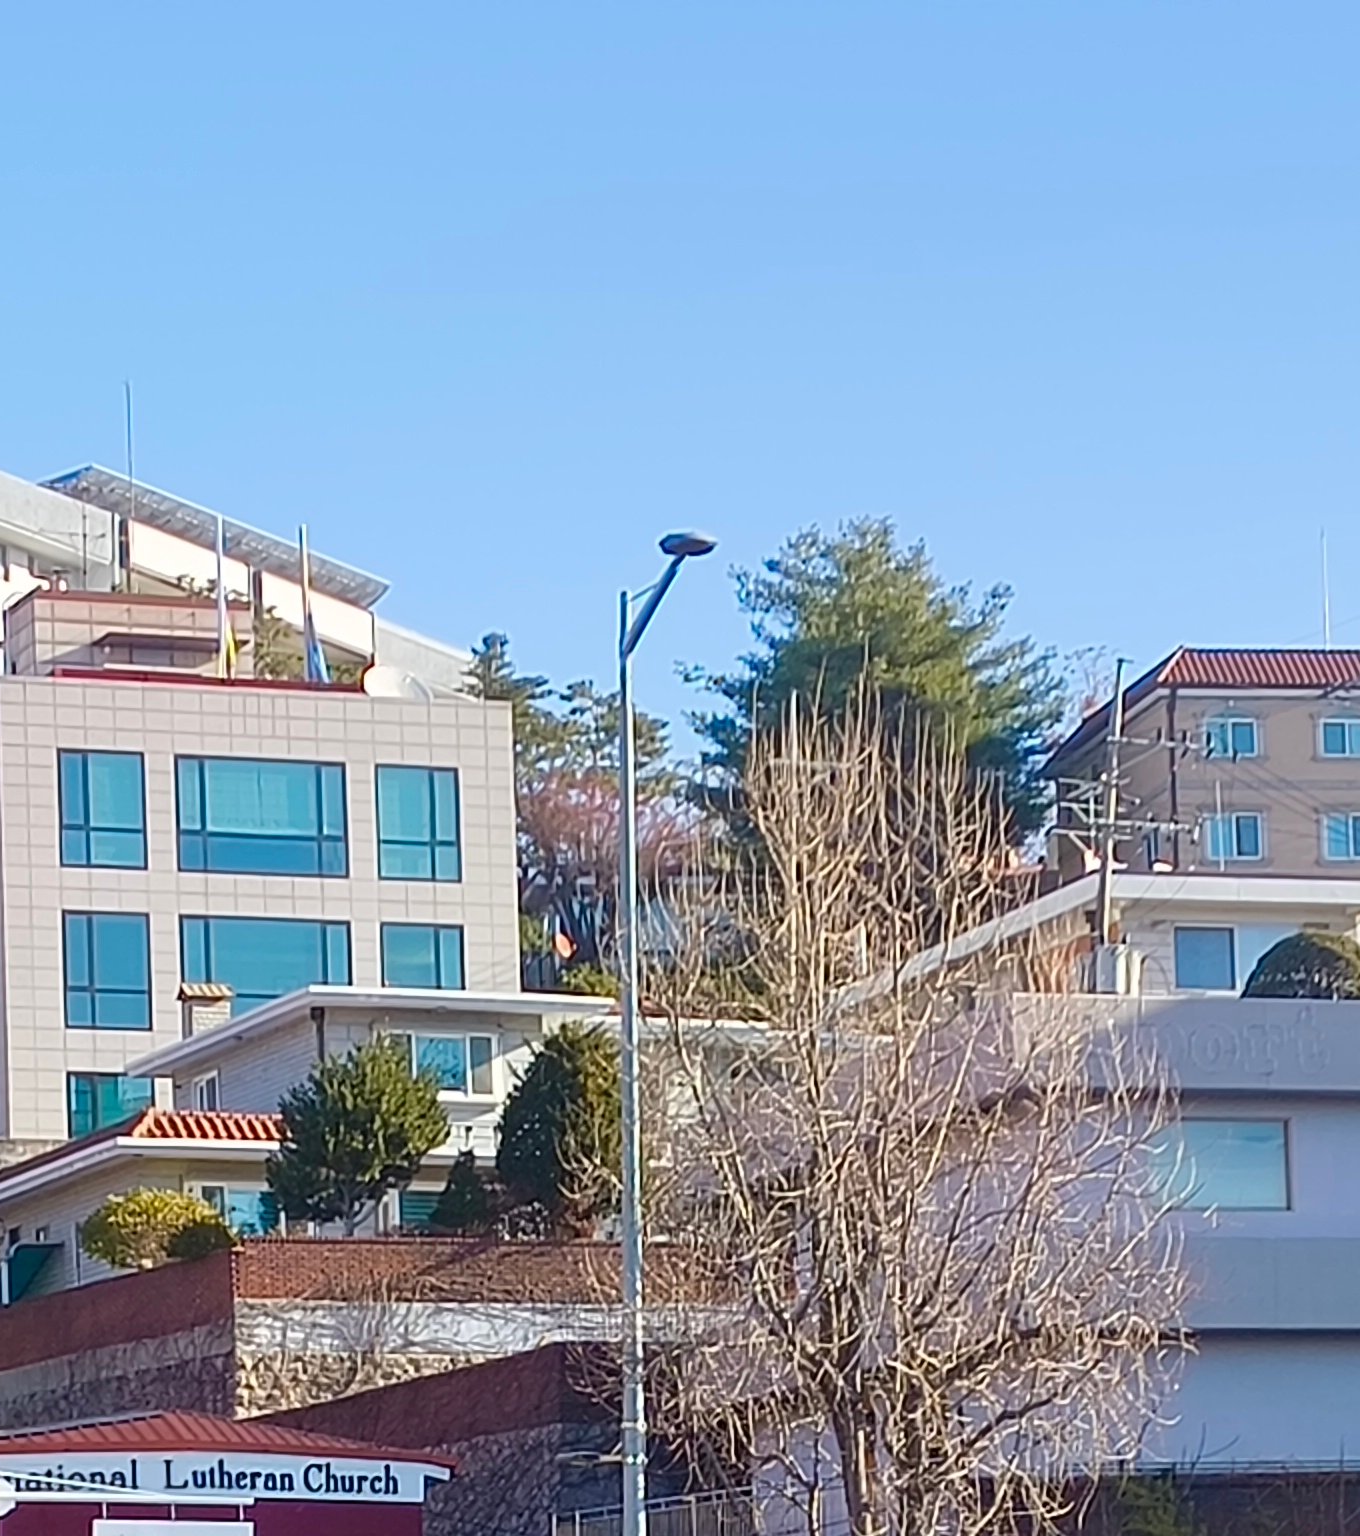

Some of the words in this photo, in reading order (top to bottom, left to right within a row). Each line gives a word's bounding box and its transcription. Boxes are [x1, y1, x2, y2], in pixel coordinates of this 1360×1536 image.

[1072, 1005, 1331, 1080] port
[162, 1458, 295, 1493] Lutheran
[302, 1461, 400, 1495] Church
